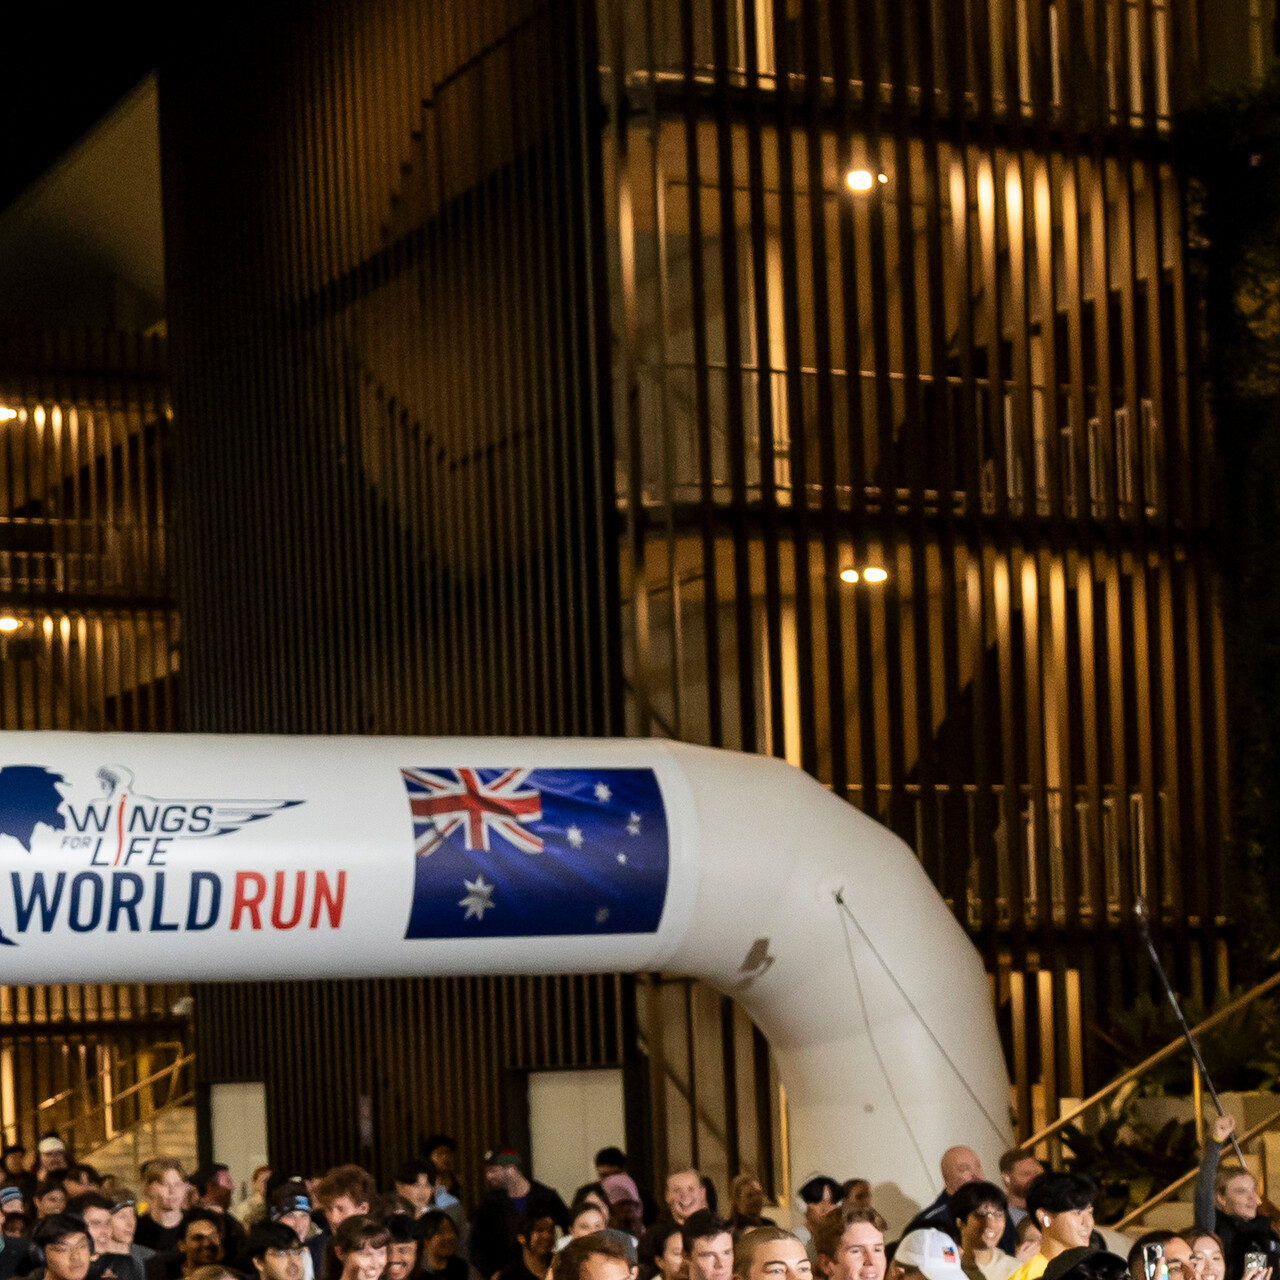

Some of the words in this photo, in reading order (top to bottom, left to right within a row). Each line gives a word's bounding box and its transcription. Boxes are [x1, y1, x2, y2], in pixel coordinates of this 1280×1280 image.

[67, 800, 214, 833] WINGS
[60, 835, 92, 850] FOR
[90, 837, 174, 868] LIFE
[10, 870, 222, 934] WORLD
[229, 869, 348, 932] RUN
